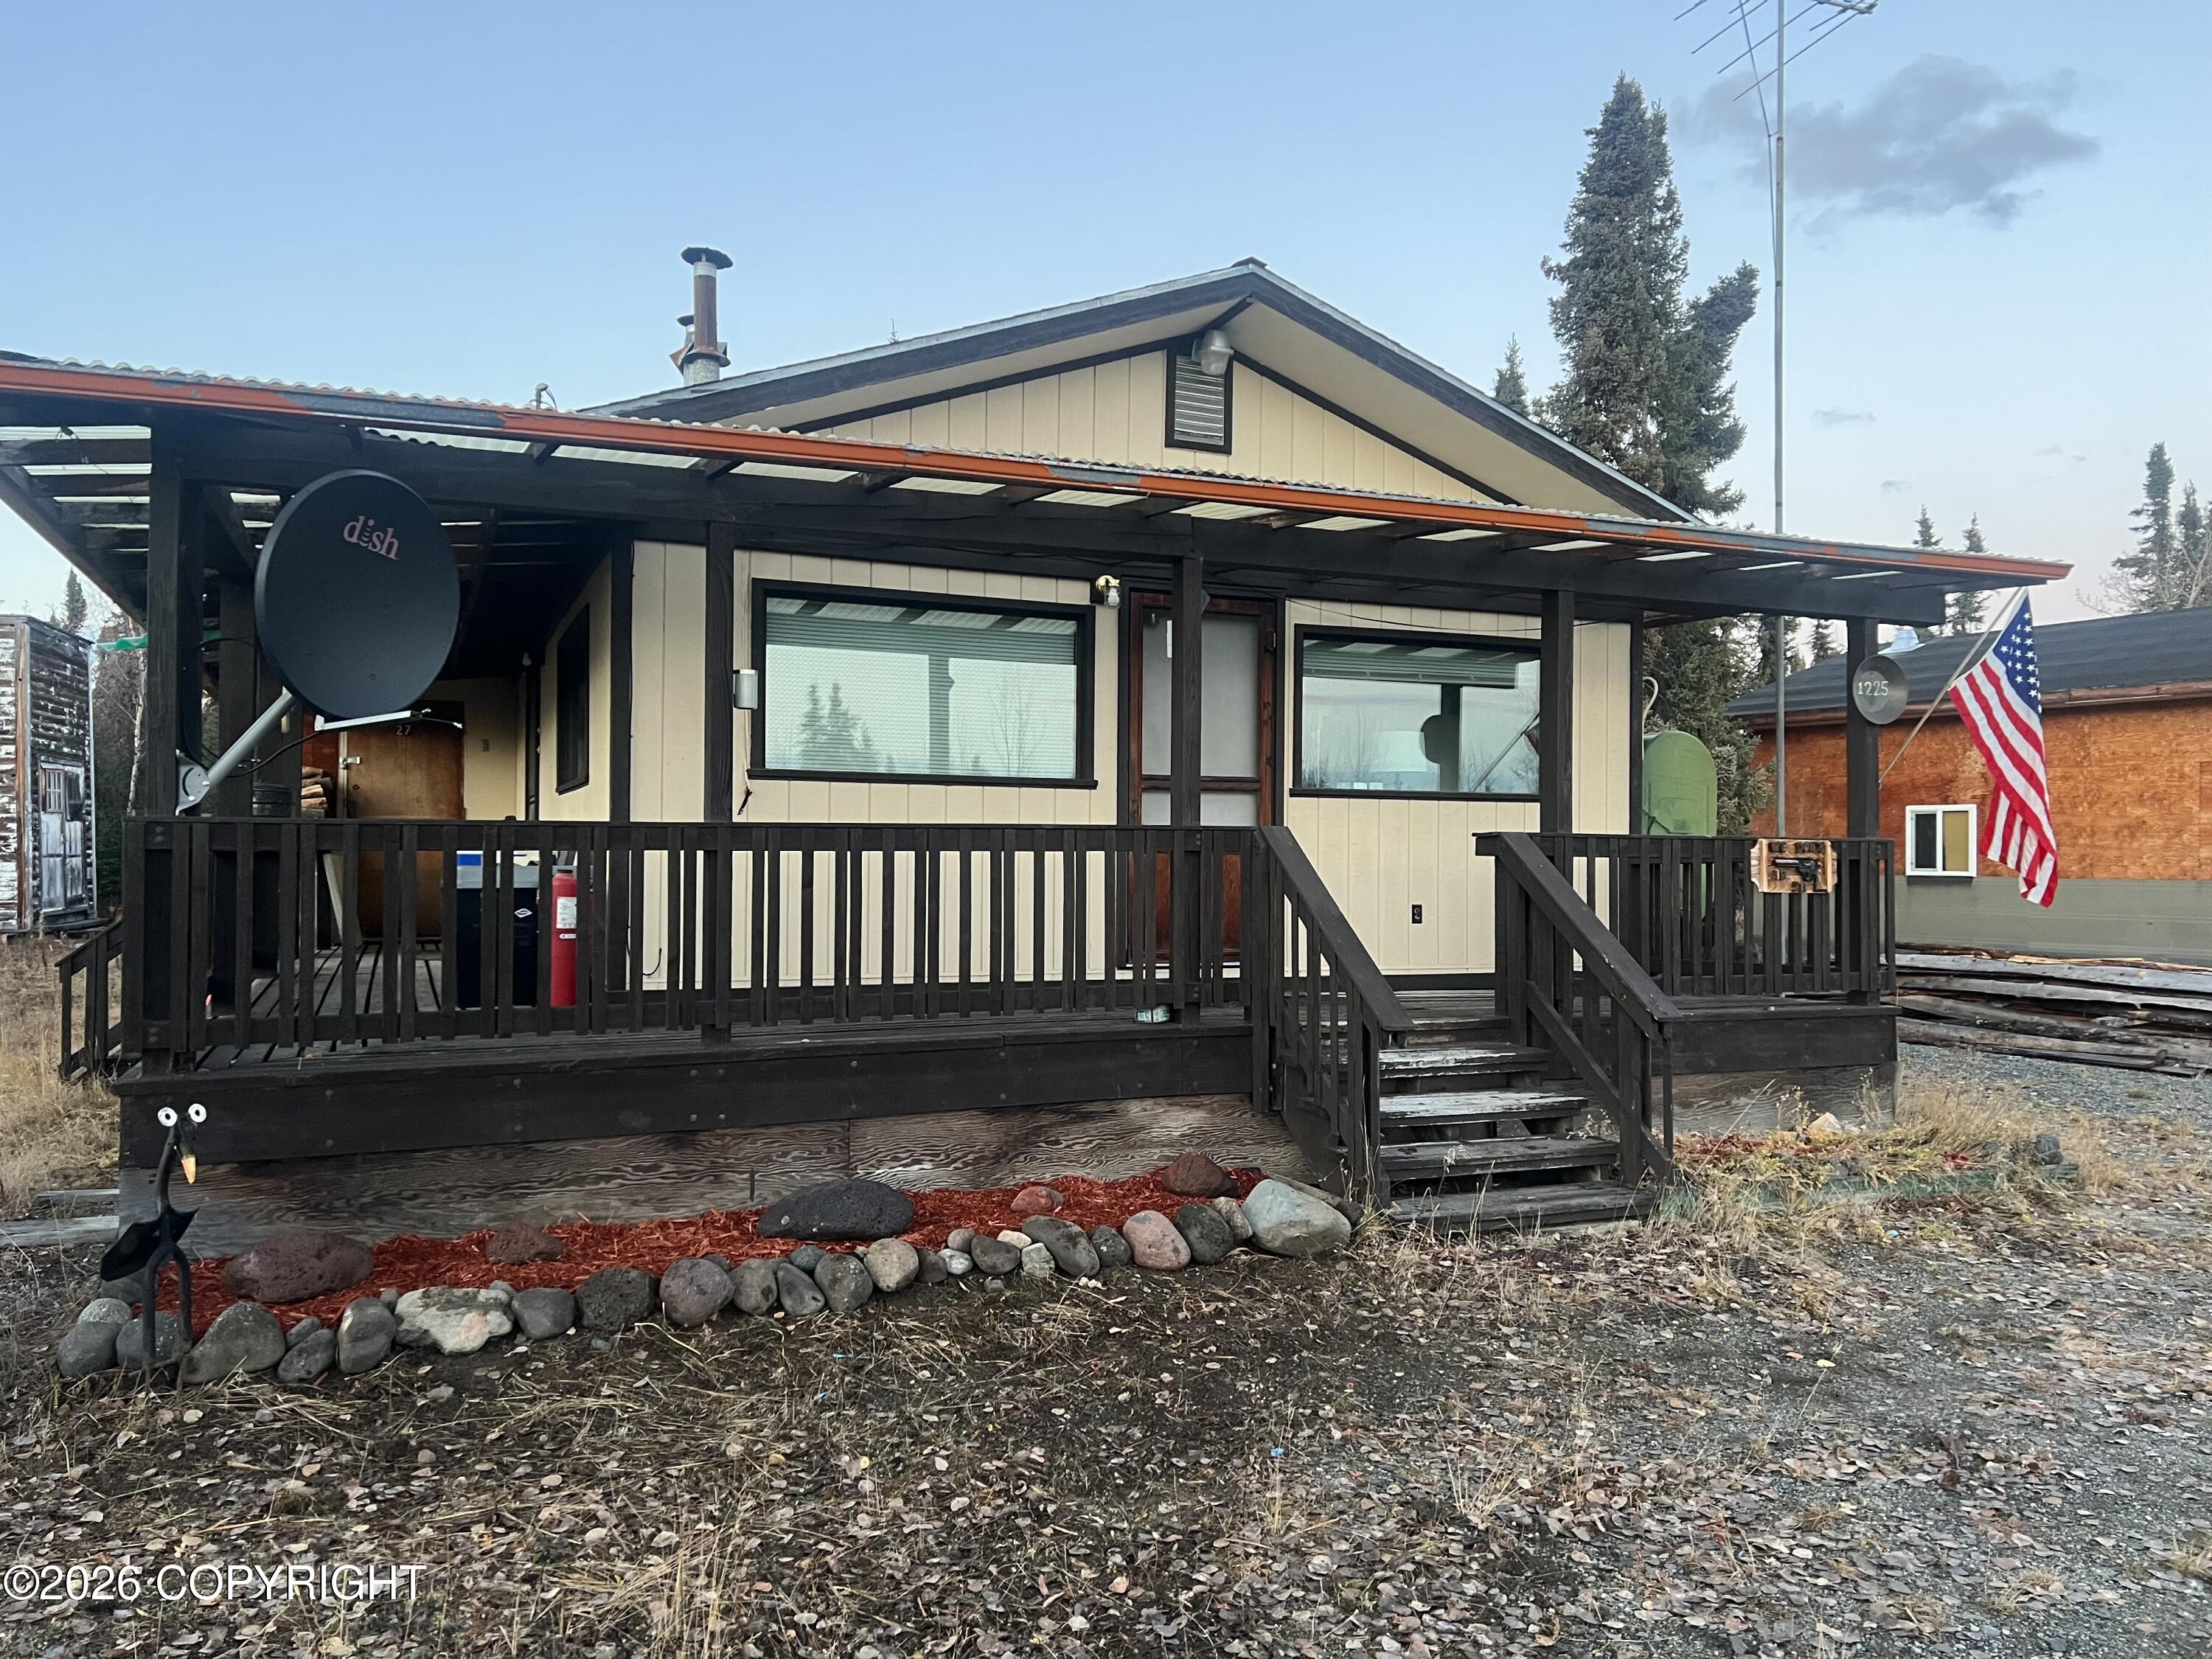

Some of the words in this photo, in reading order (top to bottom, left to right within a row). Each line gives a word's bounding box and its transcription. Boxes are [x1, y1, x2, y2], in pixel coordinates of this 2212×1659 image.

[343, 515, 400, 560] dish
[1857, 681, 1889, 696] 1225
[396, 725, 411, 735] 27
